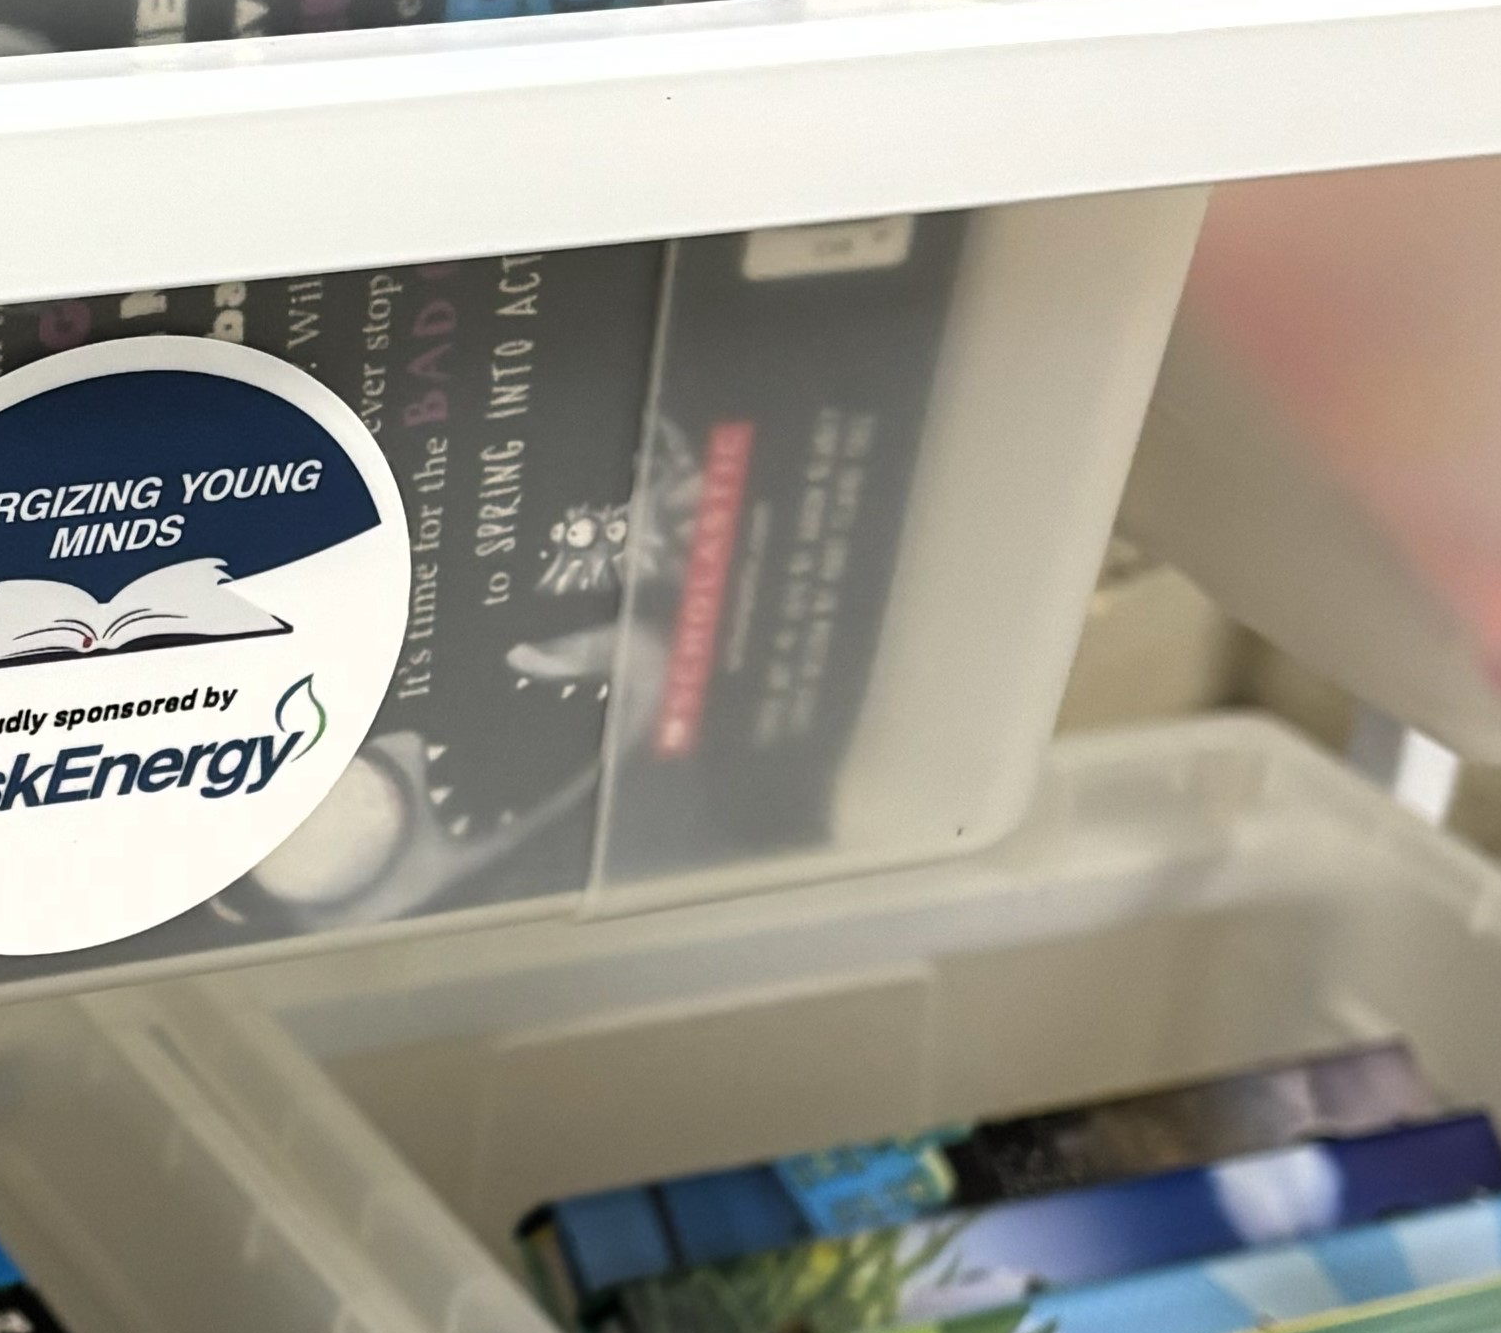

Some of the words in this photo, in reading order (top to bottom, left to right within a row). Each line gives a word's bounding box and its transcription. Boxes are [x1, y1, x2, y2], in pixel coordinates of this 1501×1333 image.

[364, 272, 405, 351] stop
[403, 298, 458, 428] BAD
[484, 338, 537, 421] INTO
[180, 459, 323, 505] YOUNG
[411, 436, 449, 494] the
[474, 439, 526, 558] SPRING
[49, 515, 185, 559] MINDS
[481, 570, 512, 607] to
[52, 688, 197, 731] sponsored
[202, 684, 239, 712] by
